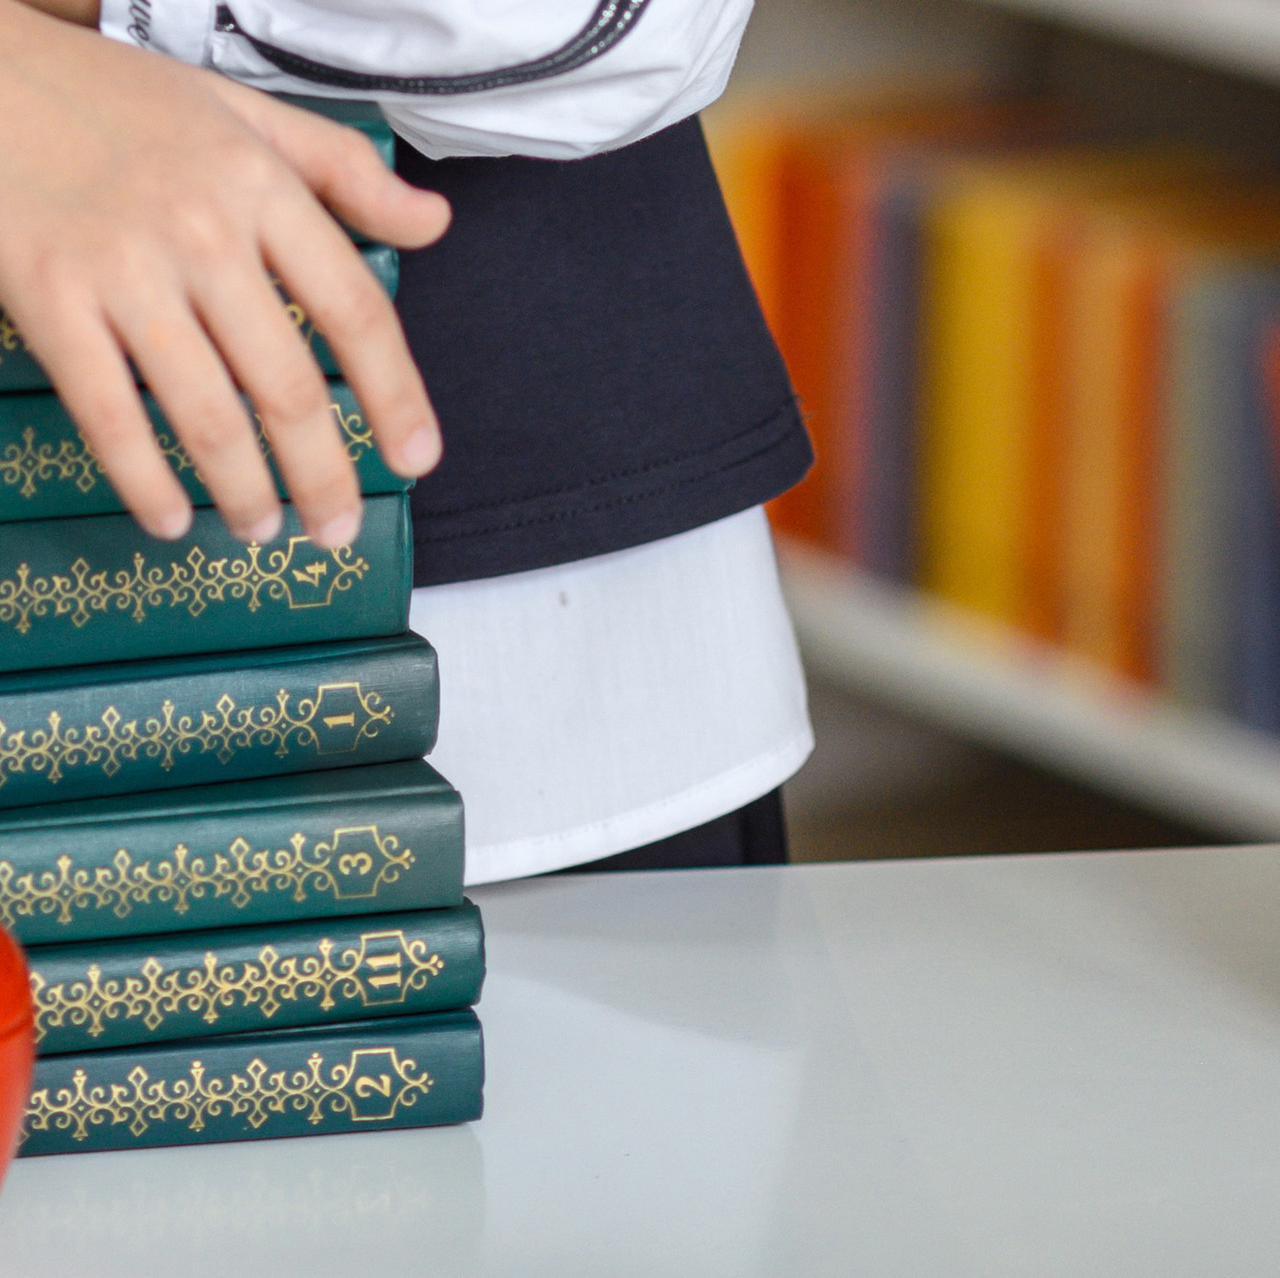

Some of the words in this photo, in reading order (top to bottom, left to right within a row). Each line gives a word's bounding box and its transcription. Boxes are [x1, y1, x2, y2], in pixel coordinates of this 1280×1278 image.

[293, 561, 326, 587] 4
[323, 712, 355, 729] 1
[338, 851, 374, 875] 3
[367, 952, 403, 988] 11
[356, 1073, 391, 1099] 2
